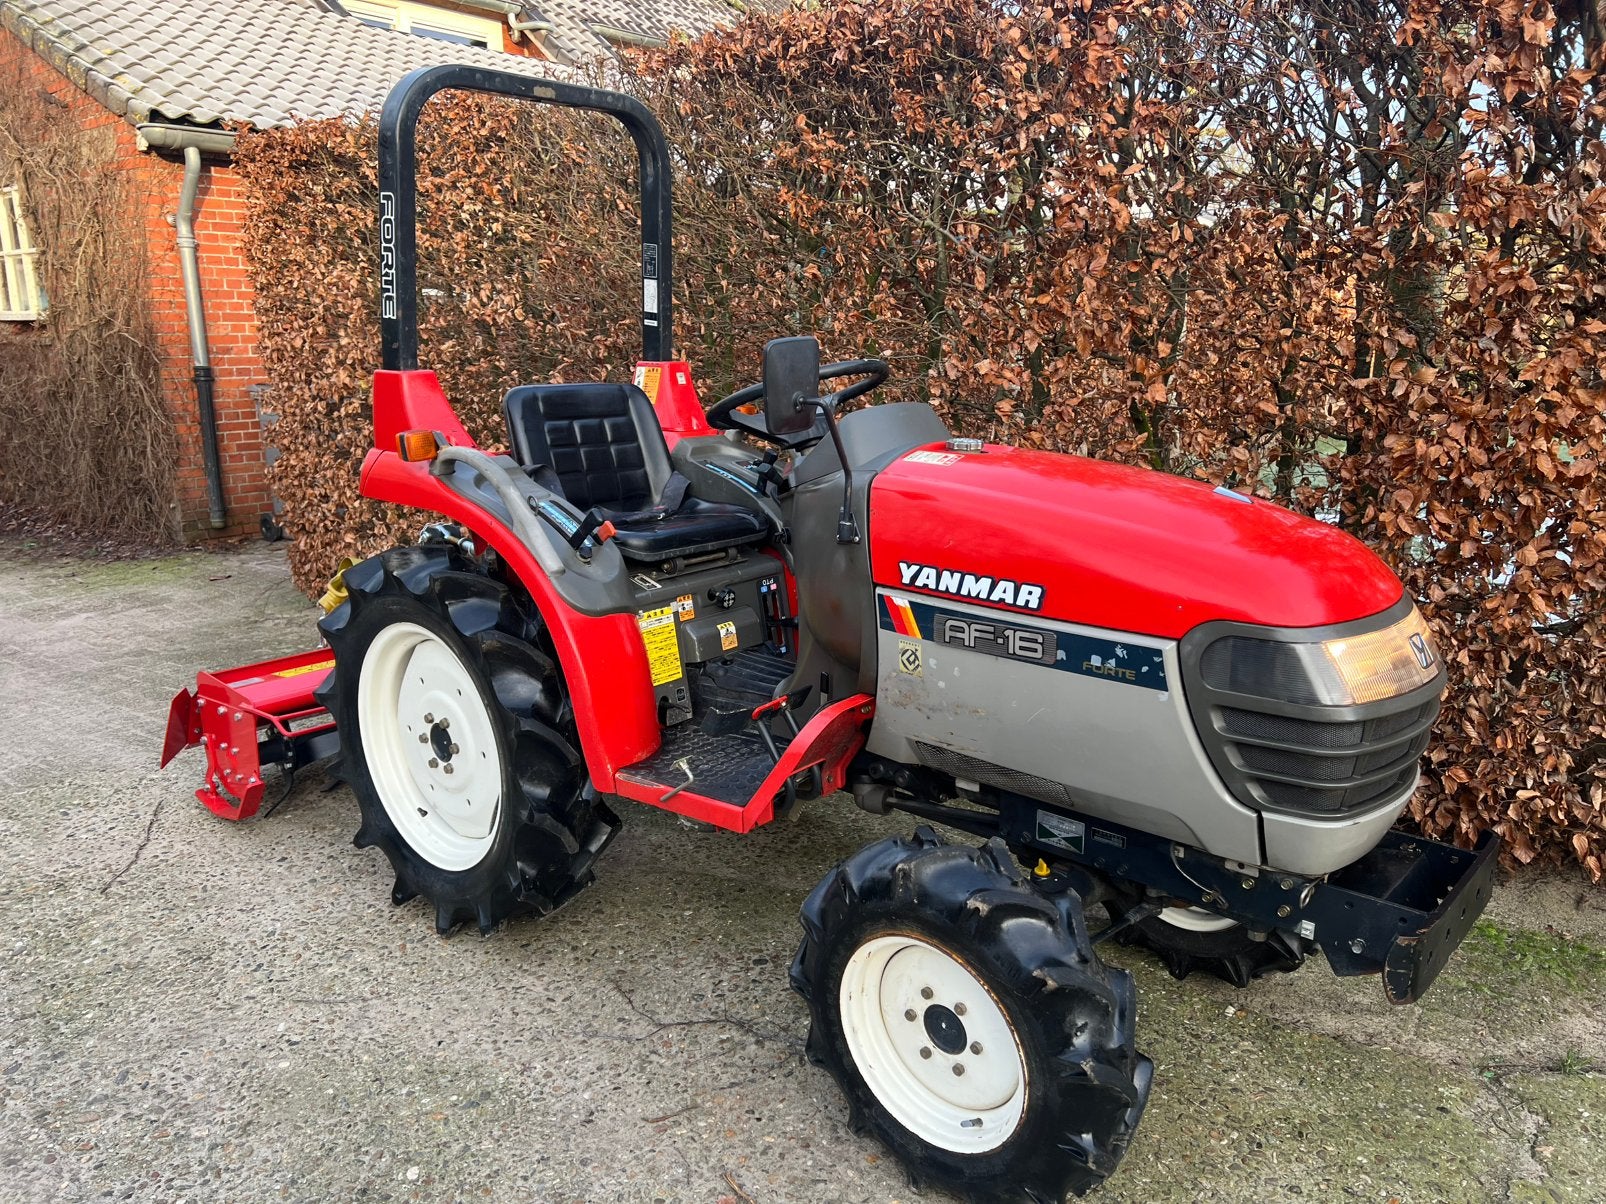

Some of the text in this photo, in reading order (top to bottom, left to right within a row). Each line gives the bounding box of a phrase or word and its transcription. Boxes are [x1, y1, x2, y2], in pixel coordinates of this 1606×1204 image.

[380, 191, 397, 320] FORTE
[899, 562, 1043, 609] YANMAR
[1082, 660, 1136, 681] FORTE
